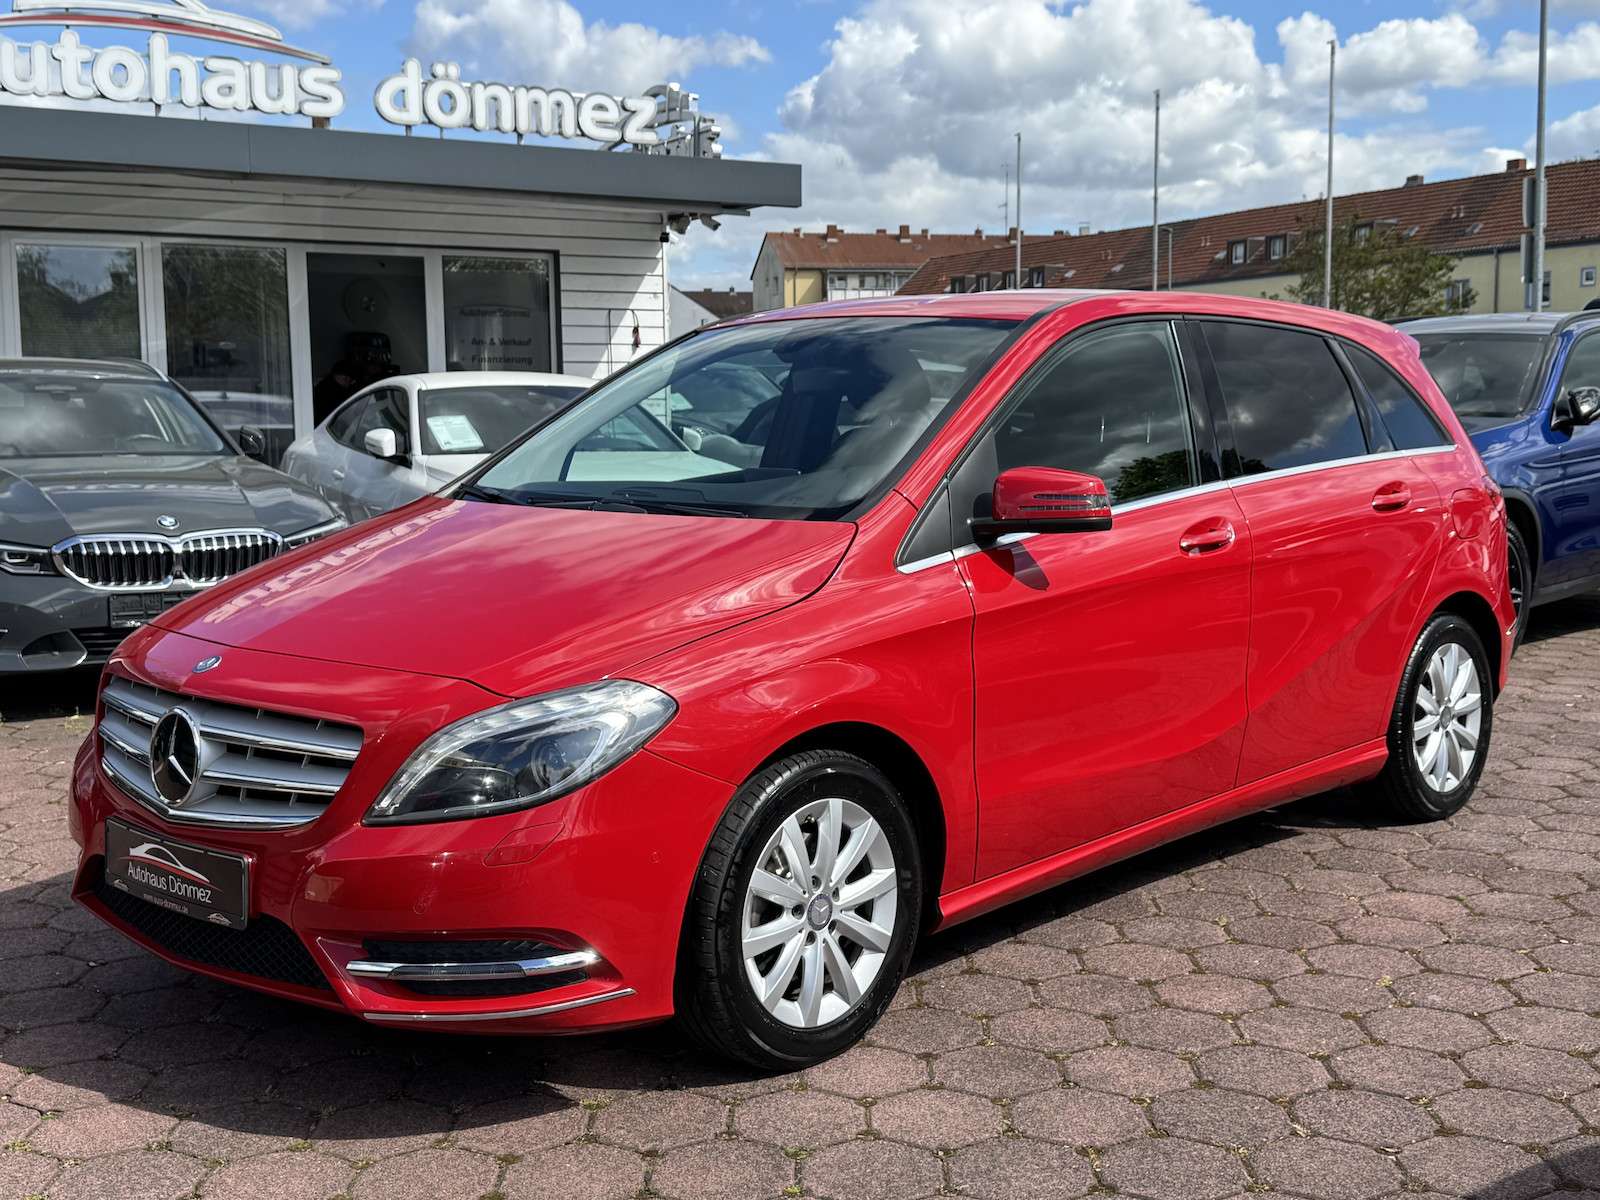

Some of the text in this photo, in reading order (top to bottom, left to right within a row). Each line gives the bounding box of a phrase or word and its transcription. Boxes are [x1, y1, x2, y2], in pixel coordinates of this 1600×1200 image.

[0, 29, 659, 144] utohaus dönmez
[498, 337, 532, 346] Verkauf
[472, 354, 533, 365] Finanzierung
[128, 861, 168, 890] Autohaus
[168, 875, 212, 904] Dönmez
